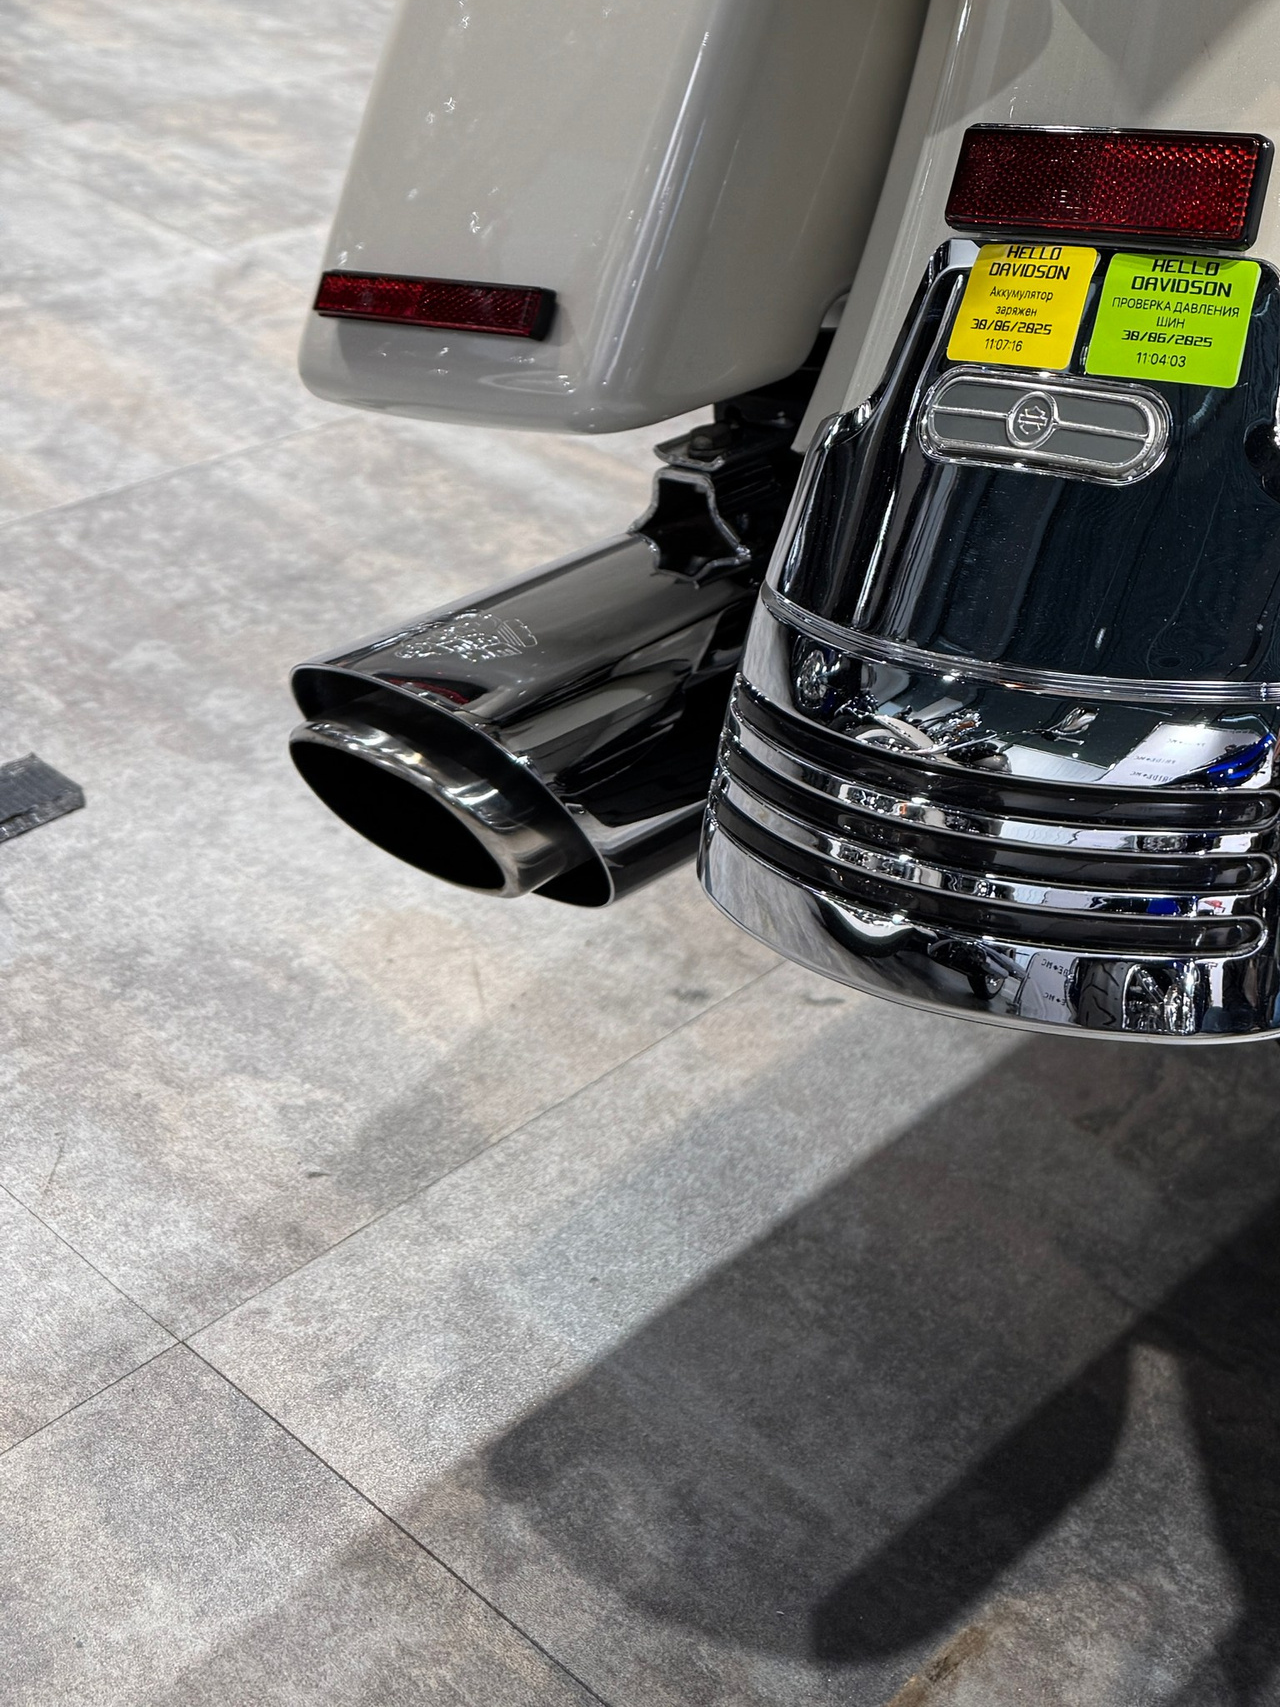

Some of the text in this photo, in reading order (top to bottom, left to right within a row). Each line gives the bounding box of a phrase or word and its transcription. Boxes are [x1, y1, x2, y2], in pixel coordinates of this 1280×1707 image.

[1006, 245, 1062, 261] HELLO
[988, 262, 1071, 281] DAVIDSON
[1151, 258, 1221, 276] HELLO
[989, 286, 1054, 303] Аккумулятор
[1131, 275, 1232, 298] DAVIDSON
[995, 305, 1038, 317] заряжен
[1111, 297, 1240, 318] ПРОВЕРКА ДАВЛЕНИЯ
[970, 318, 1053, 336] 30/06/2025
[1156, 316, 1186, 329] ШИН
[985, 338, 1024, 352] 11:07:16
[1121, 329, 1213, 348] 30/06/2025
[1136, 352, 1187, 368] 11:04:03
